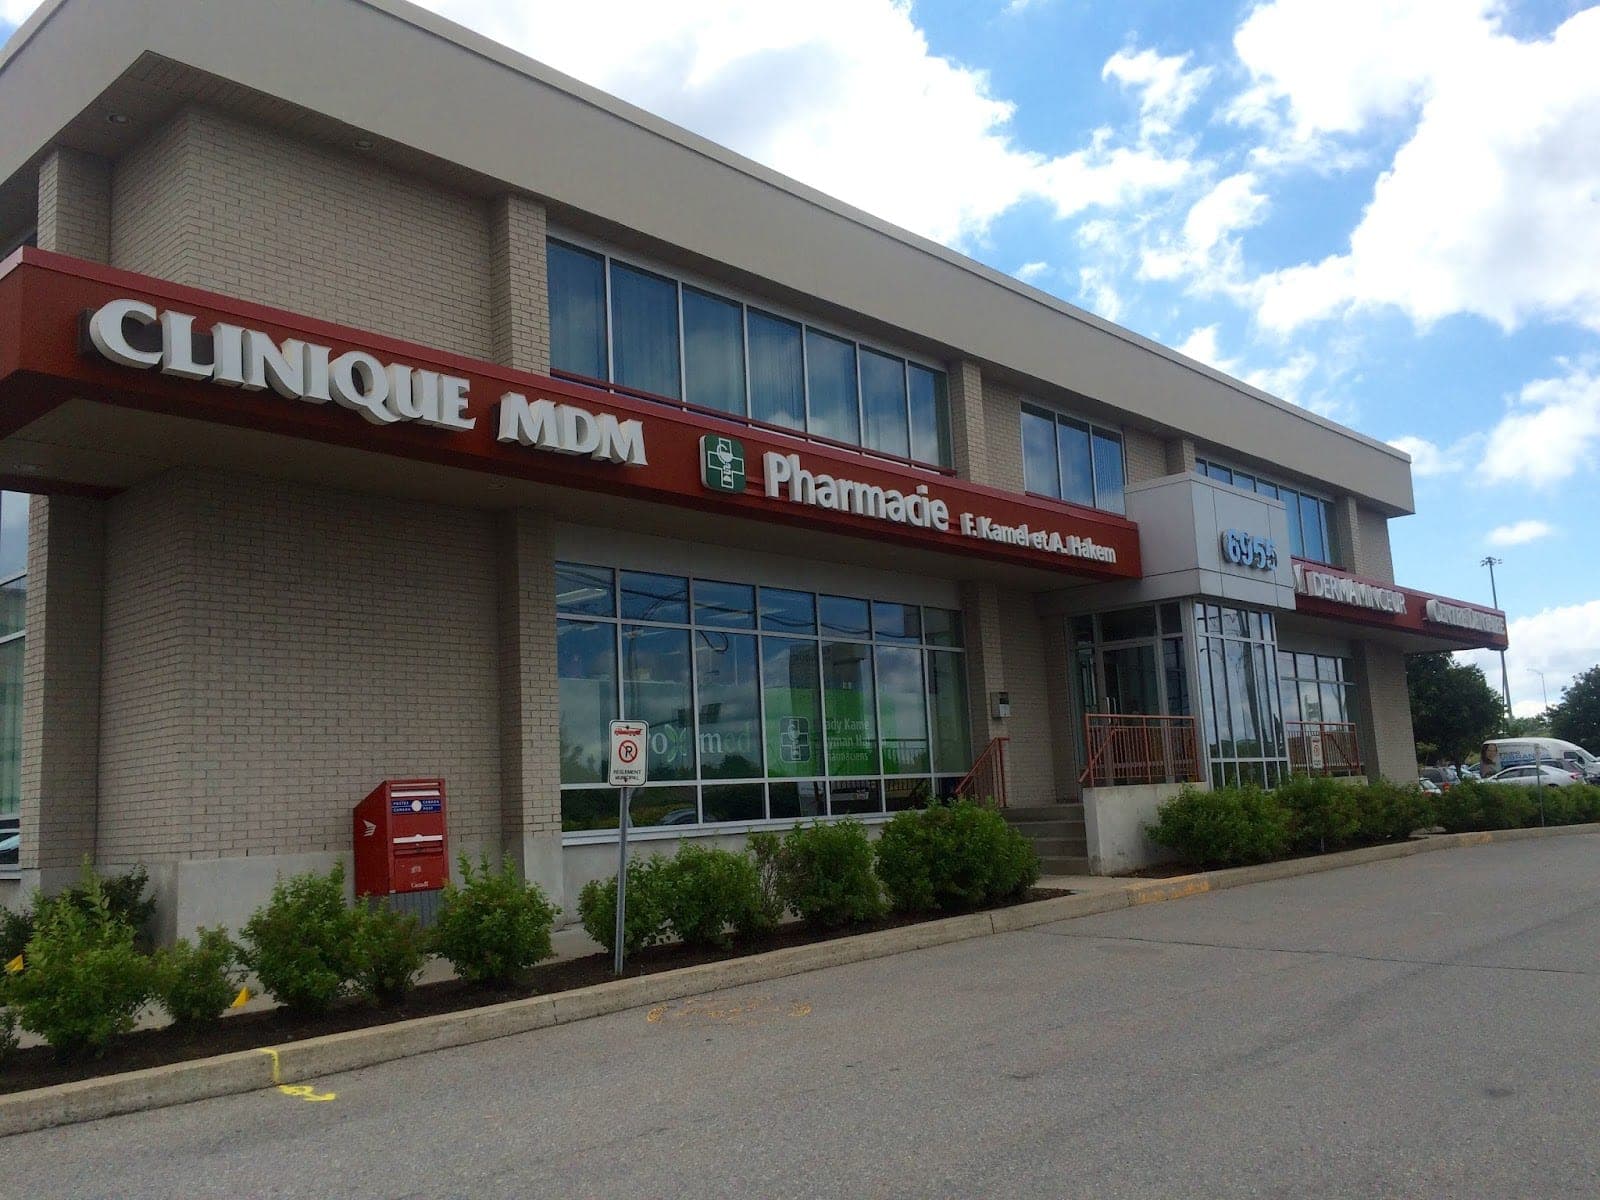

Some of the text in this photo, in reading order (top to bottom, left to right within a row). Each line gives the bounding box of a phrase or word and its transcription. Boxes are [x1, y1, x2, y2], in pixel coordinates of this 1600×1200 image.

[89, 297, 648, 467] CLINIQUE MDM
[762, 450, 950, 532] Pharmacie
[959, 512, 978, 537] F.
[976, 515, 1030, 548] Kamel
[1029, 529, 1049, 551] et
[1065, 535, 1118, 565] Hakem
